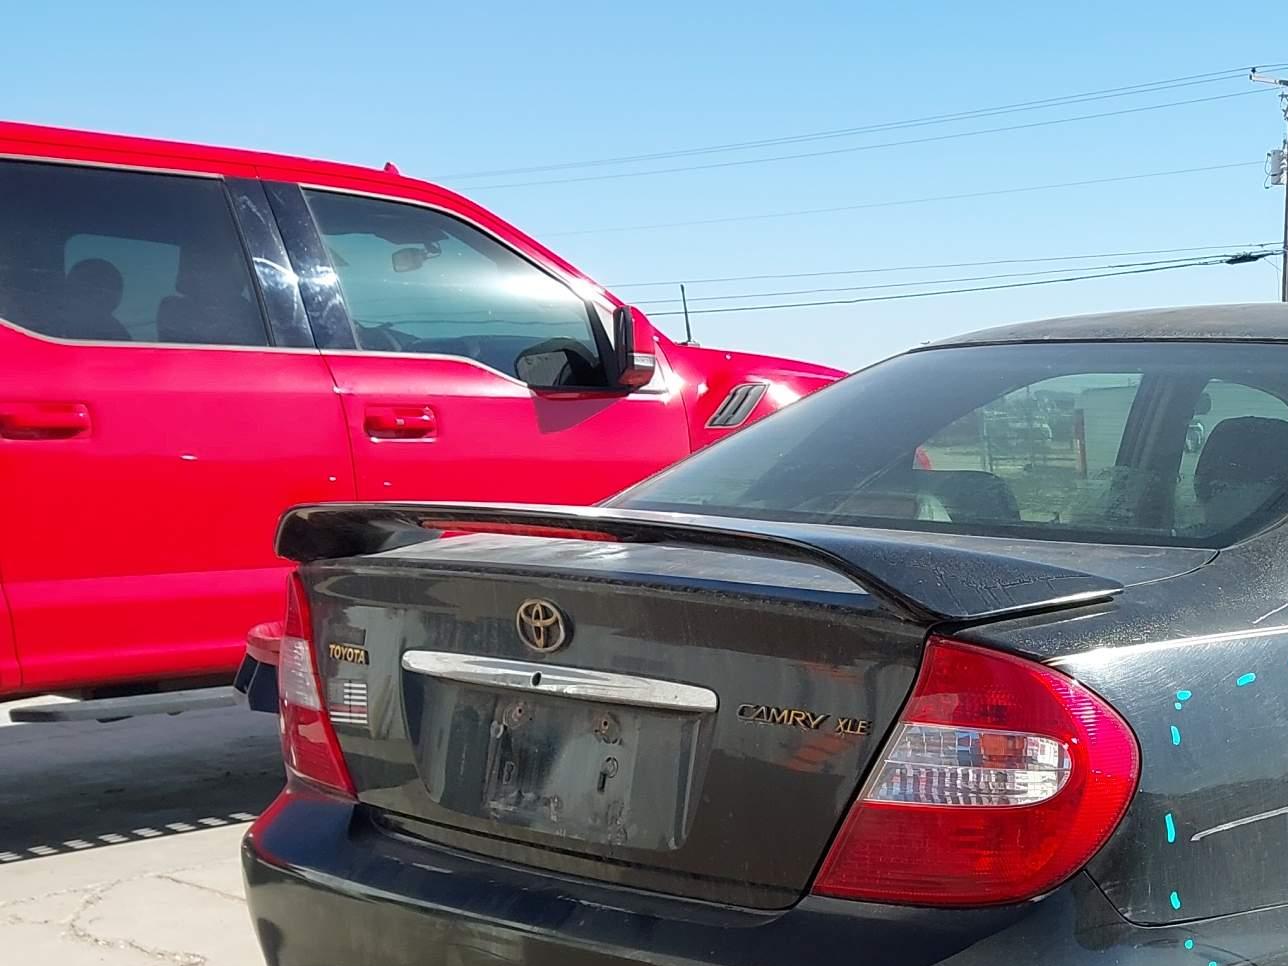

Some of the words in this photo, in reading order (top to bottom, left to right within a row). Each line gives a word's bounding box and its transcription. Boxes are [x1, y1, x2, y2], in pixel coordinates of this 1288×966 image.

[328, 644, 366, 665] TOYOTA
[735, 703, 830, 730] CAMRY
[834, 717, 871, 736] XLE
